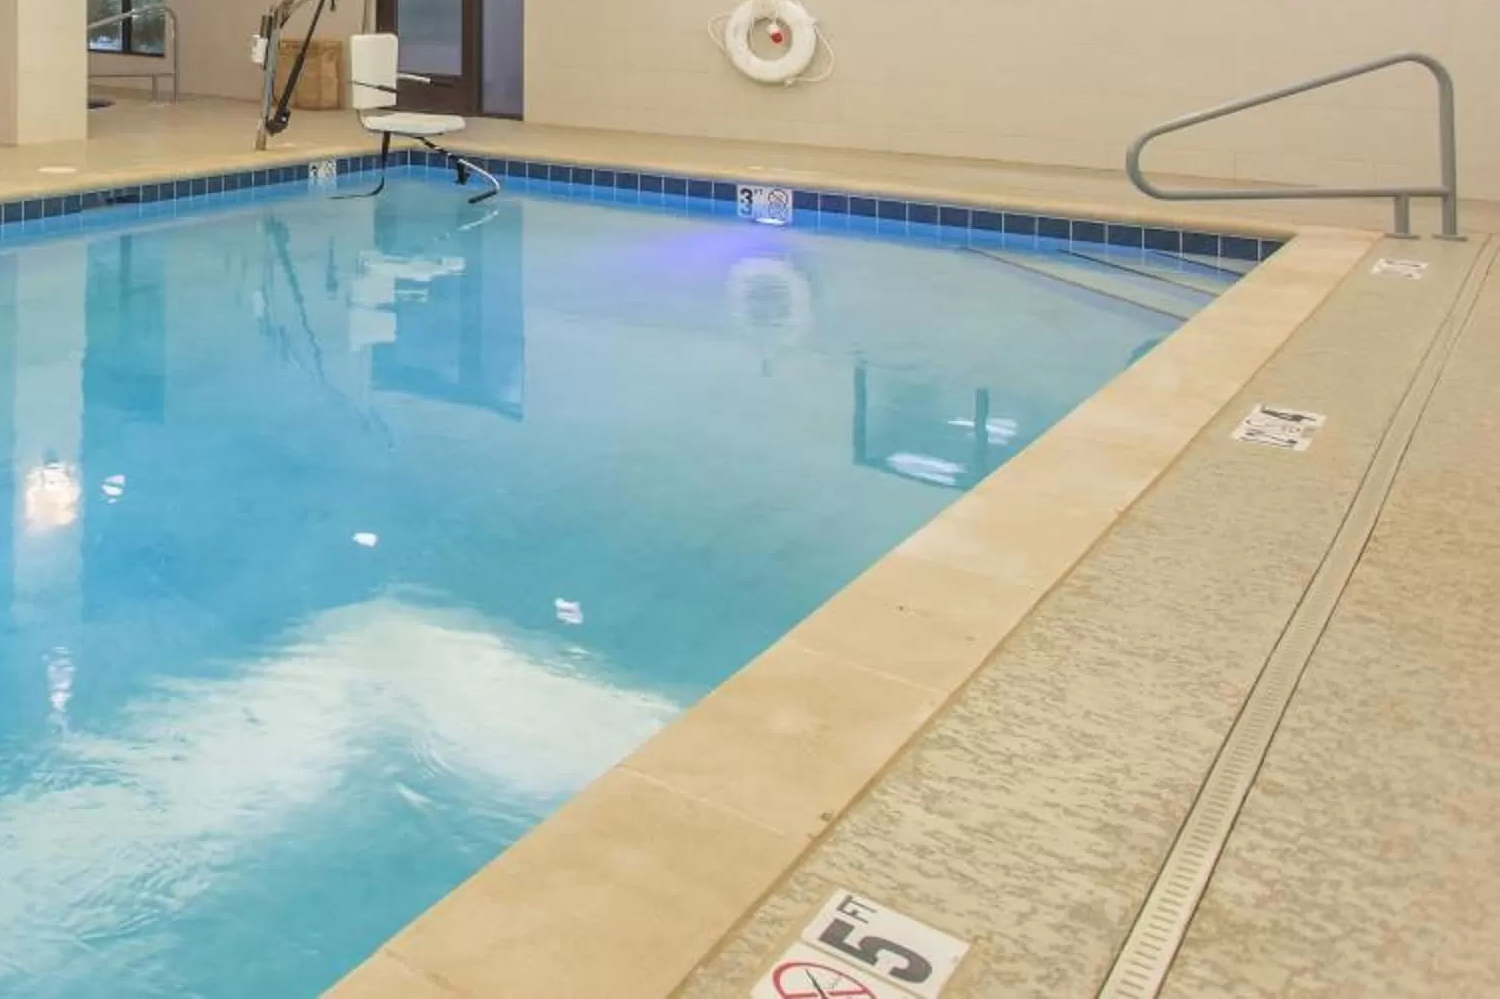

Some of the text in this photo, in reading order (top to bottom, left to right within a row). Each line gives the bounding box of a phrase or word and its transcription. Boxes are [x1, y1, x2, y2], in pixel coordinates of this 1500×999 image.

[740, 188, 753, 205] 3
[818, 894, 933, 984] 5 FT
